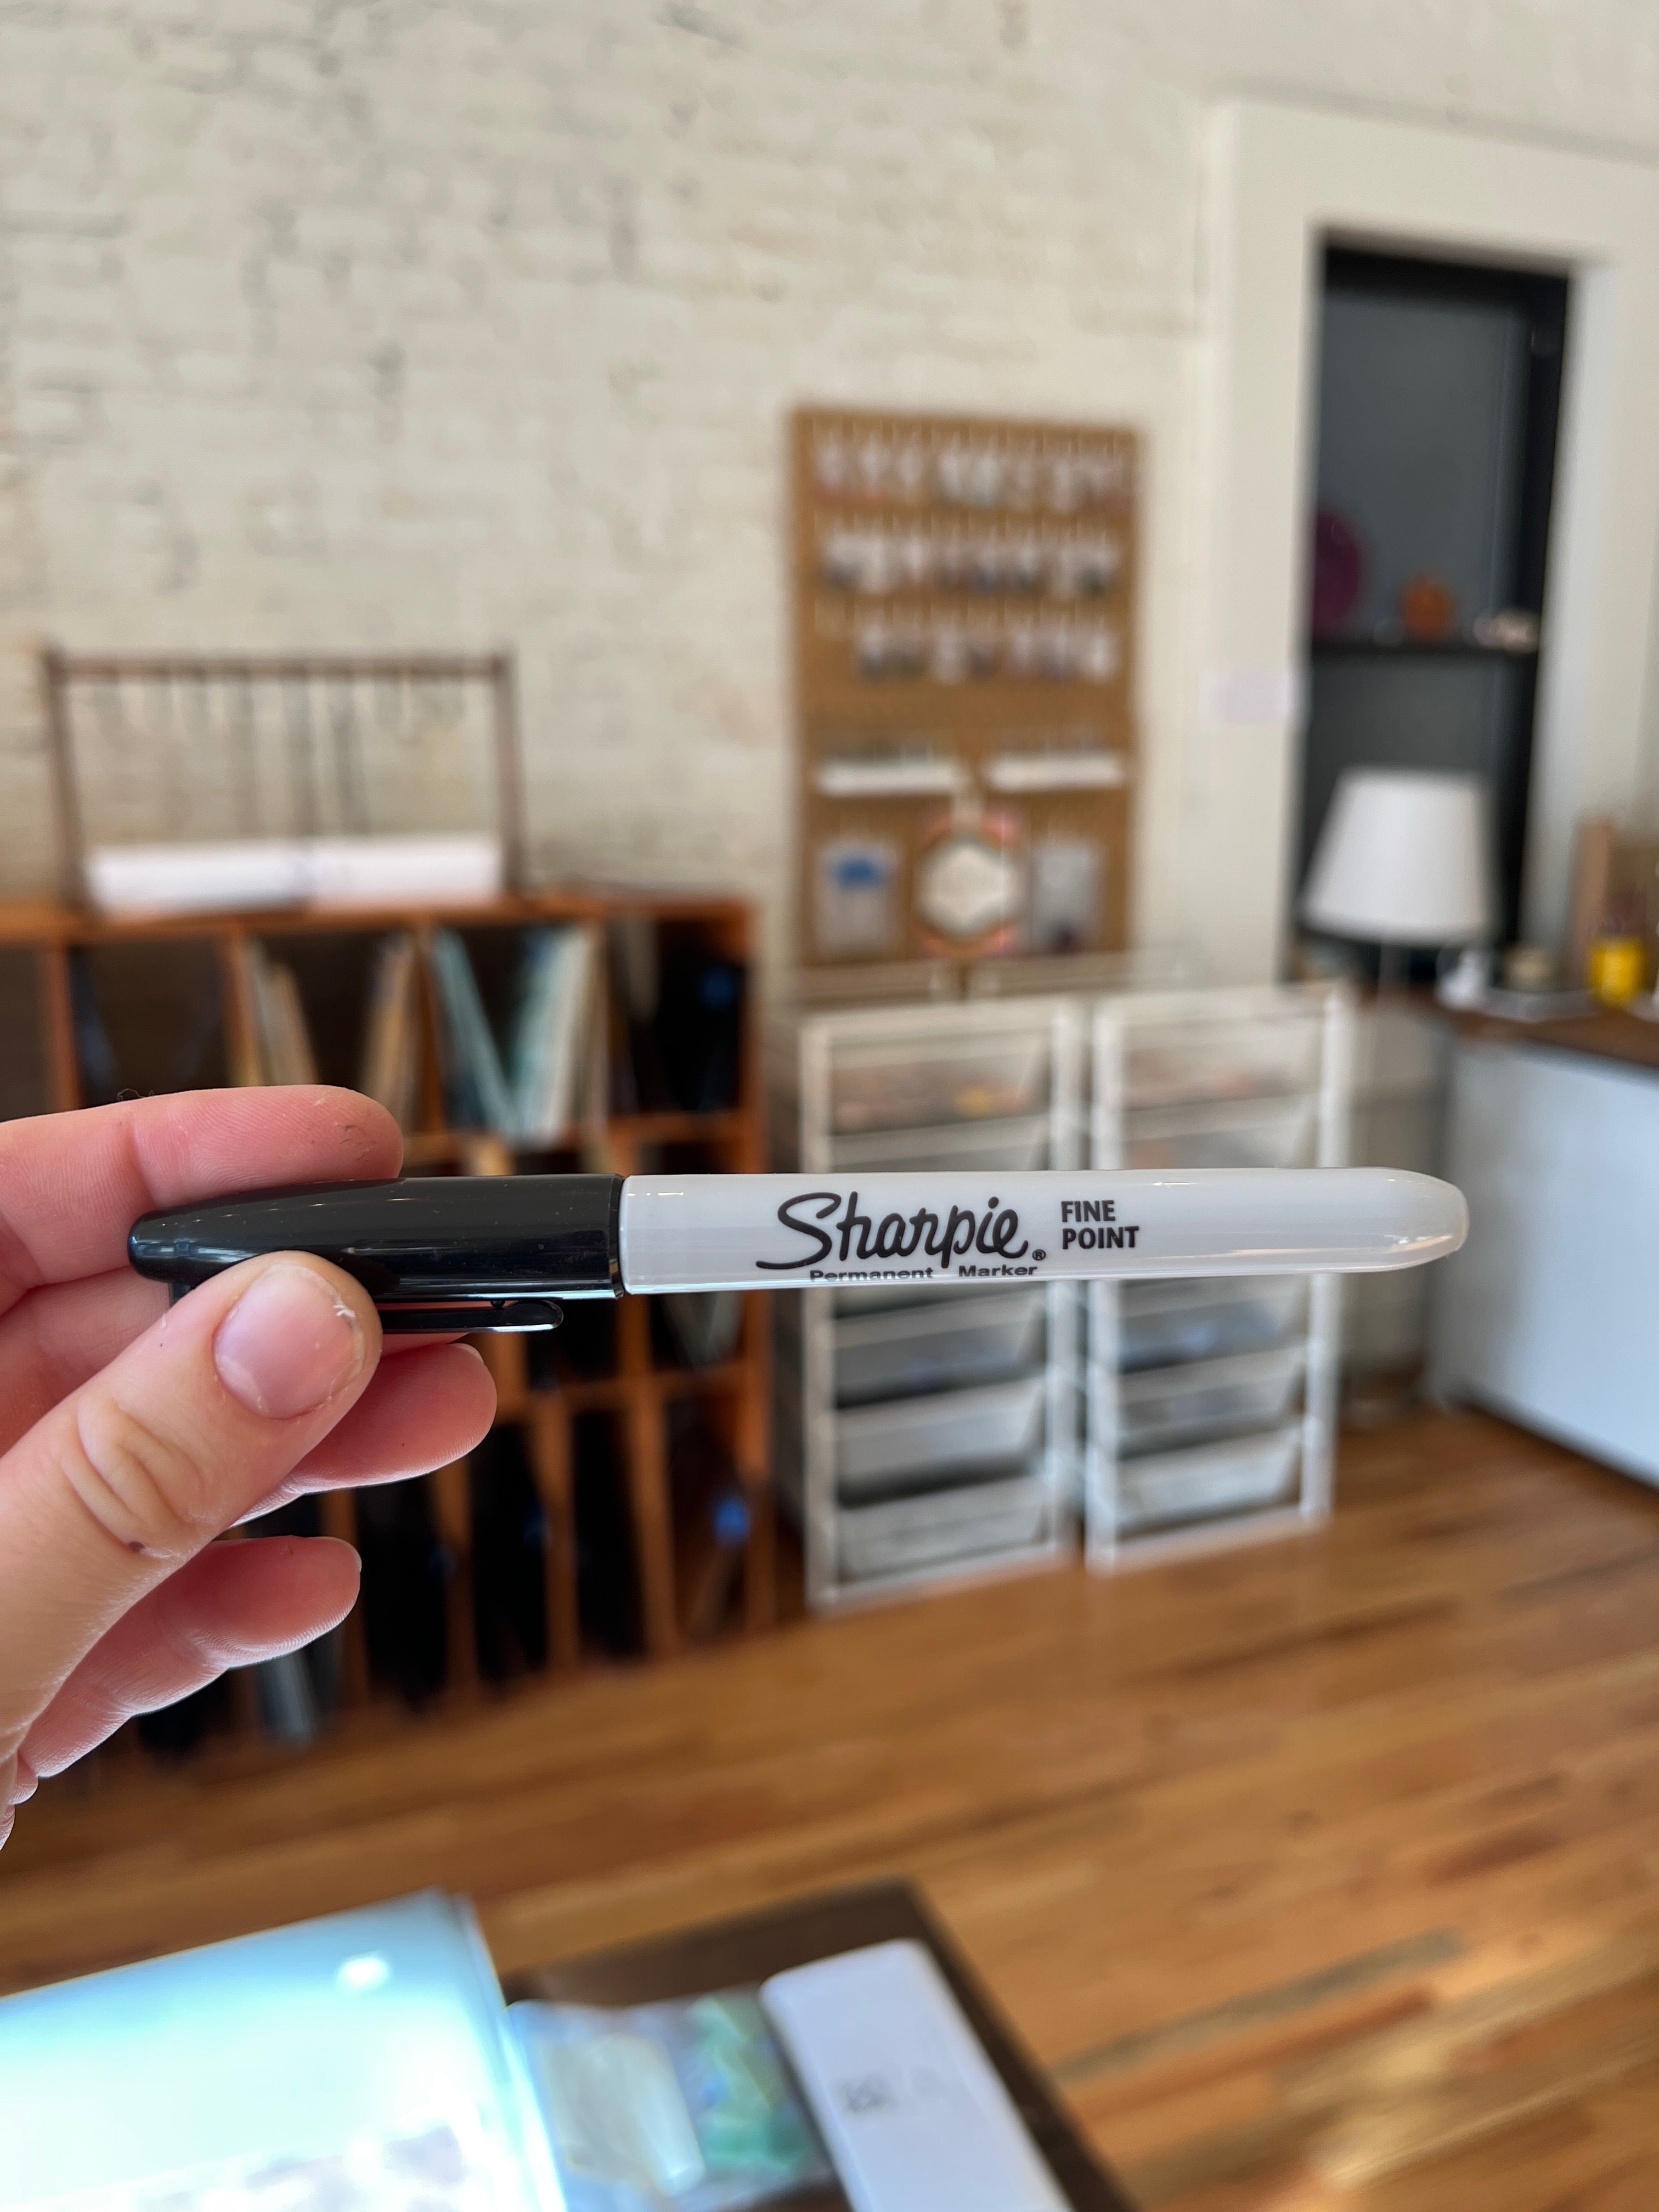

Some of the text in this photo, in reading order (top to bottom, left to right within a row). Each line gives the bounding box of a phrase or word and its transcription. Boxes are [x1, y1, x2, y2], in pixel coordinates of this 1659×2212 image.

[1061, 1200, 1116, 1223] FINE
[1062, 1226, 1139, 1250] POINT
[810, 1265, 1037, 1282] Permanent Marker
